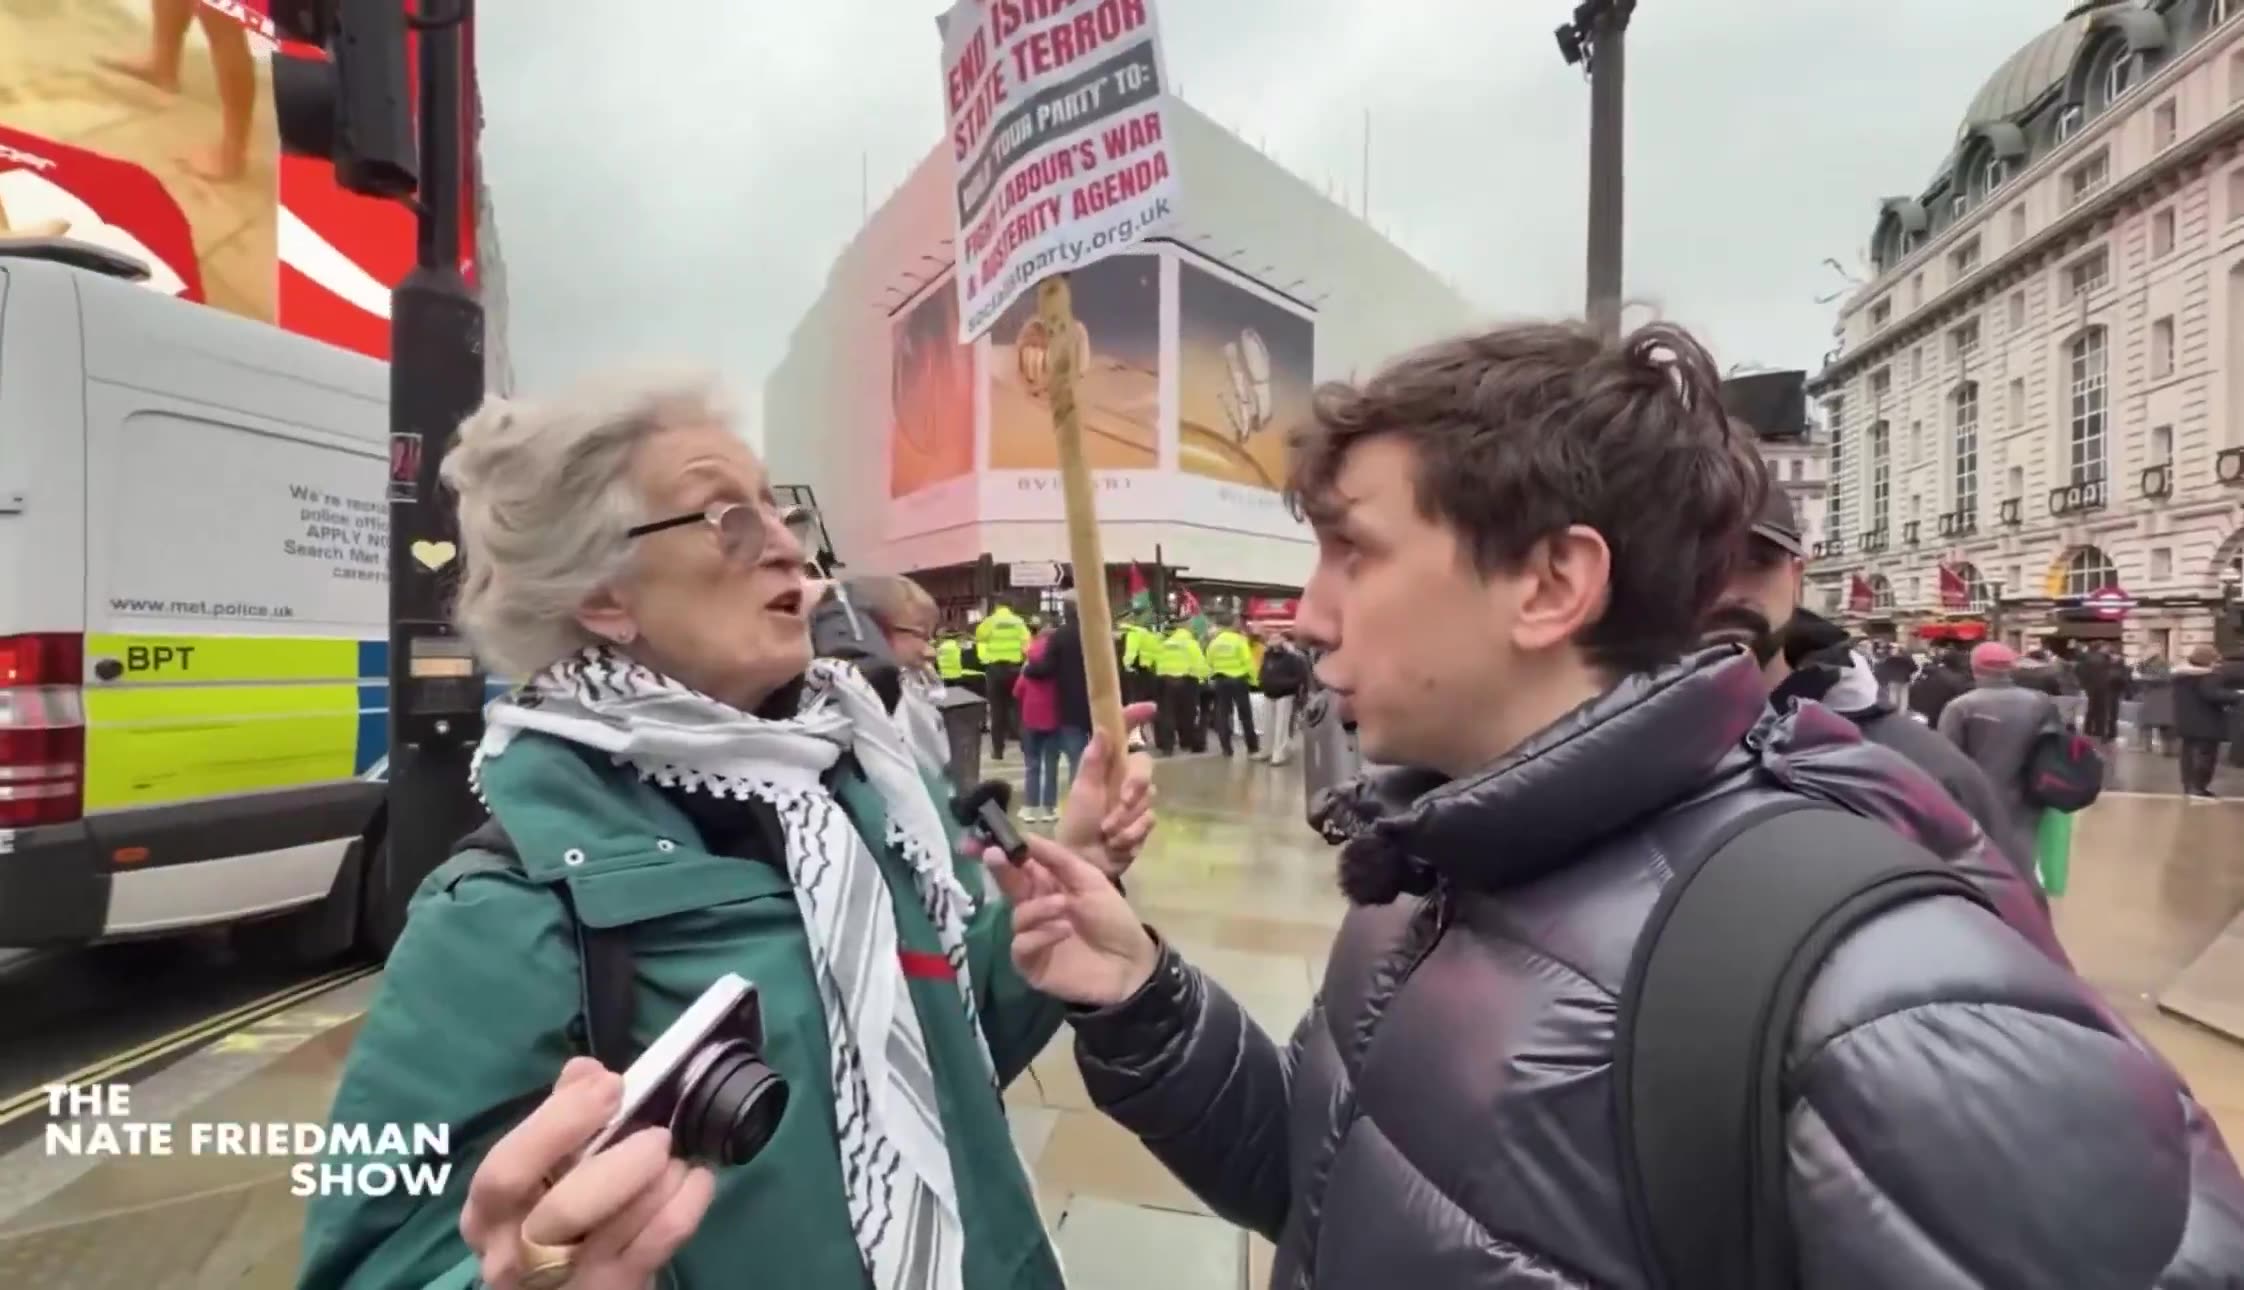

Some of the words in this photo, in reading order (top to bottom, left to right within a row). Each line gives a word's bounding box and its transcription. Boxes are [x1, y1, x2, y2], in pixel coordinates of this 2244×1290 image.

[948, 24, 987, 118] END
[954, 57, 1008, 162] STATE
[1010, 0, 1146, 83] TERROR
[1114, 62, 1150, 95] TO:
[999, 137, 1098, 220] LABOUR'S
[1102, 112, 1162, 161] WAR
[1071, 151, 1169, 221] AGENDA
[306, 524, 361, 545] APPLY
[283, 539, 343, 560] Search
[349, 547, 379, 564] Met
[109, 598, 293, 617] www.met.police.uk
[127, 646, 195, 671] BPT
